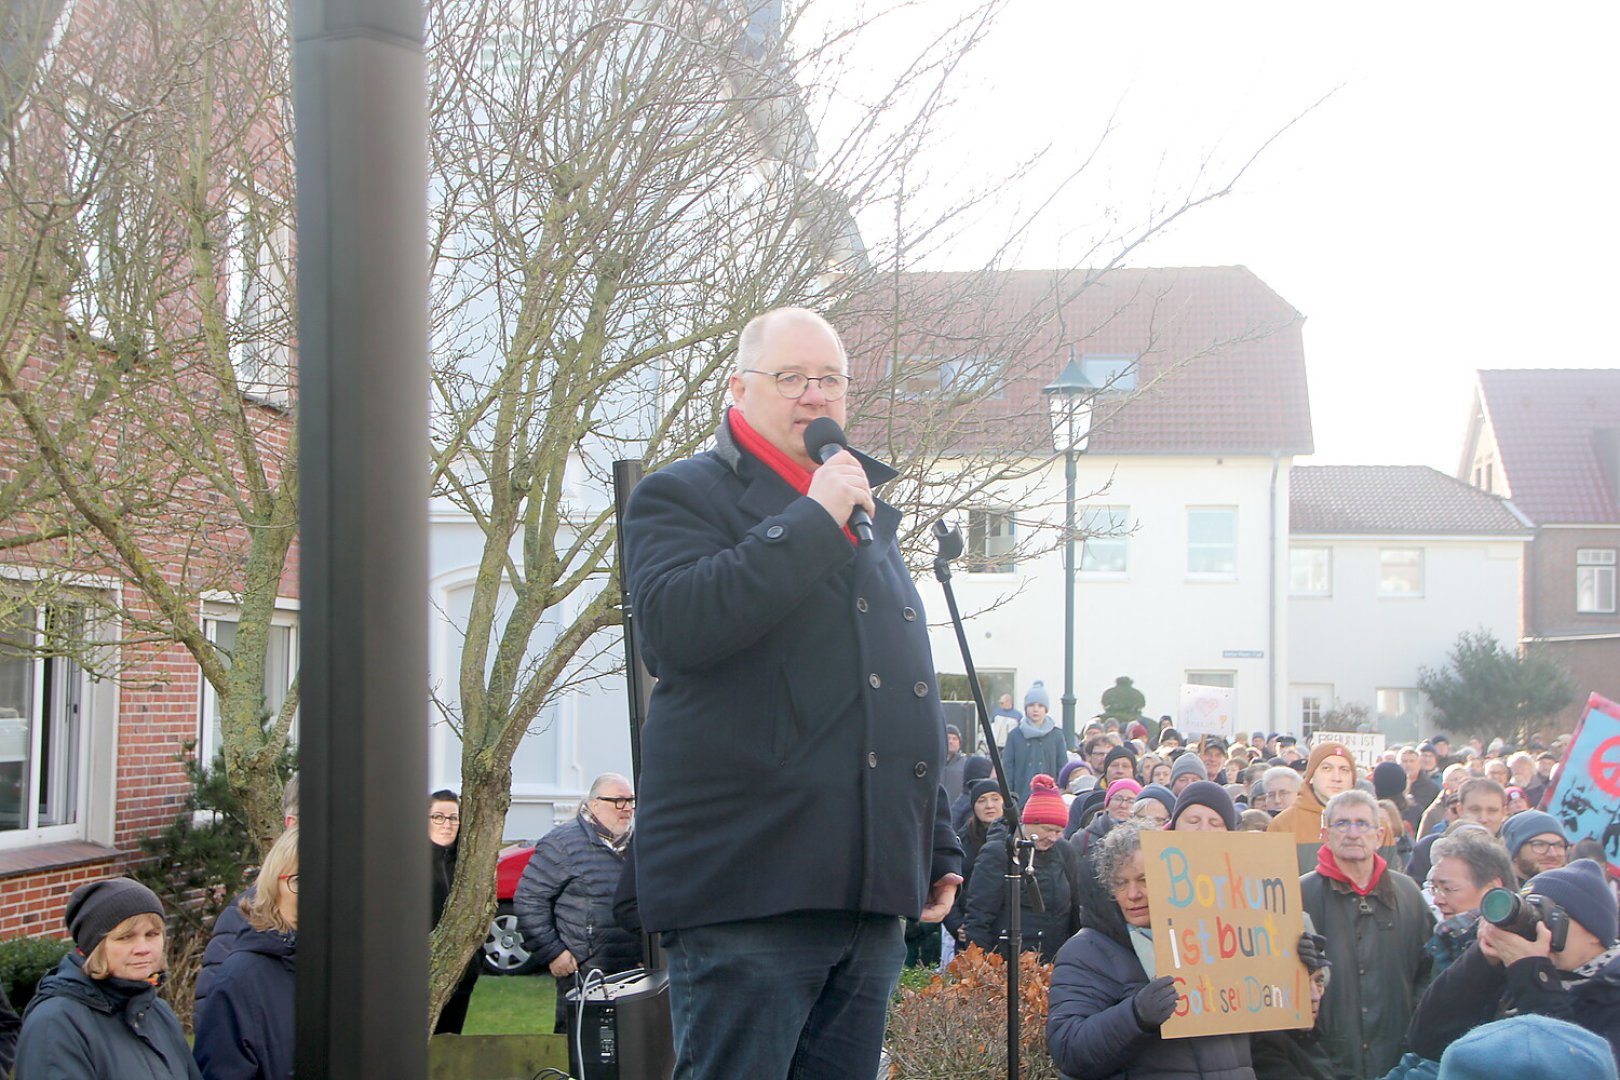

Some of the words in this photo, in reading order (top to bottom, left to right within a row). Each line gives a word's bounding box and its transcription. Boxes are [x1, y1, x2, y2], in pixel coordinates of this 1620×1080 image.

[1160, 847, 1286, 915] Borkum
[1168, 918, 1215, 969] ist
[1216, 912, 1290, 959] bunt.
[1174, 975, 1216, 1016] Gott
[1220, 981, 1241, 1013] sei
